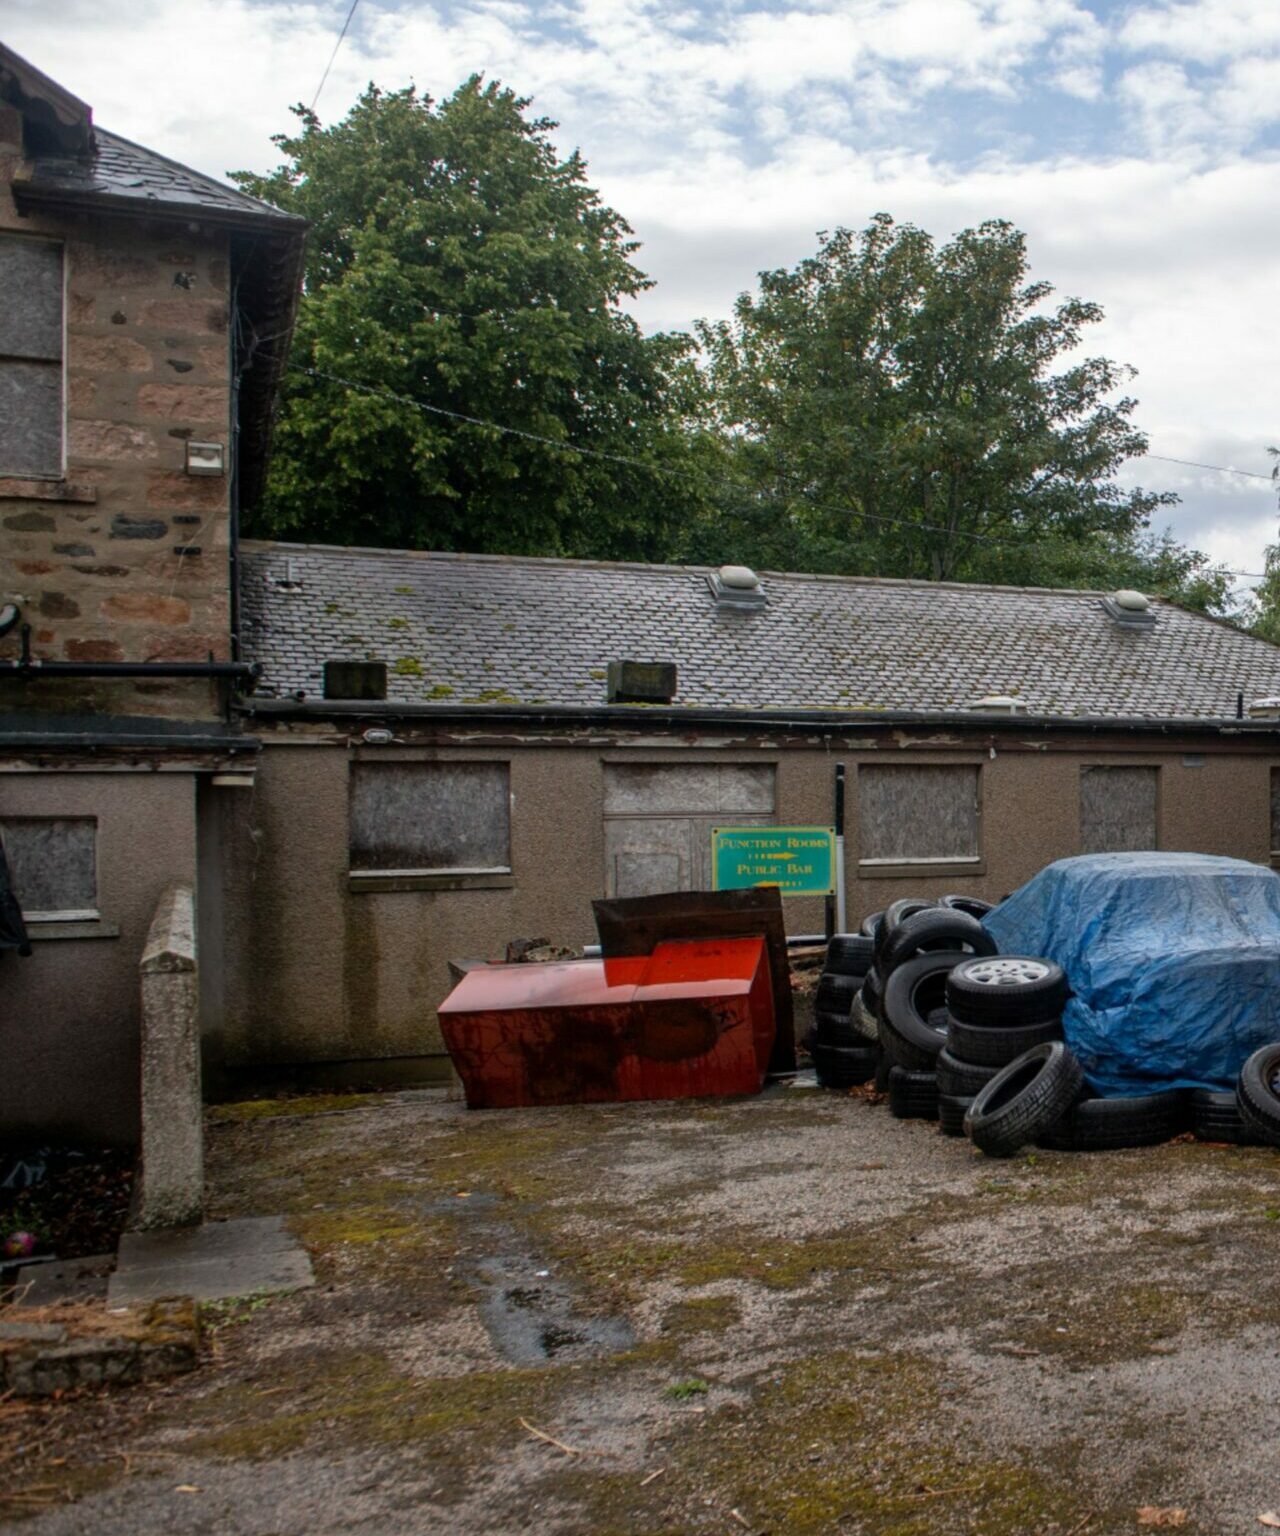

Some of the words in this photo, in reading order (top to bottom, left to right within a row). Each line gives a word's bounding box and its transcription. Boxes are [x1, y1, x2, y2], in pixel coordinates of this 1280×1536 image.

[719, 838, 782, 849] FUNCTION
[787, 837, 828, 848] ROOMS
[737, 864, 781, 875] PUBLIC
[787, 864, 812, 874] BAR
